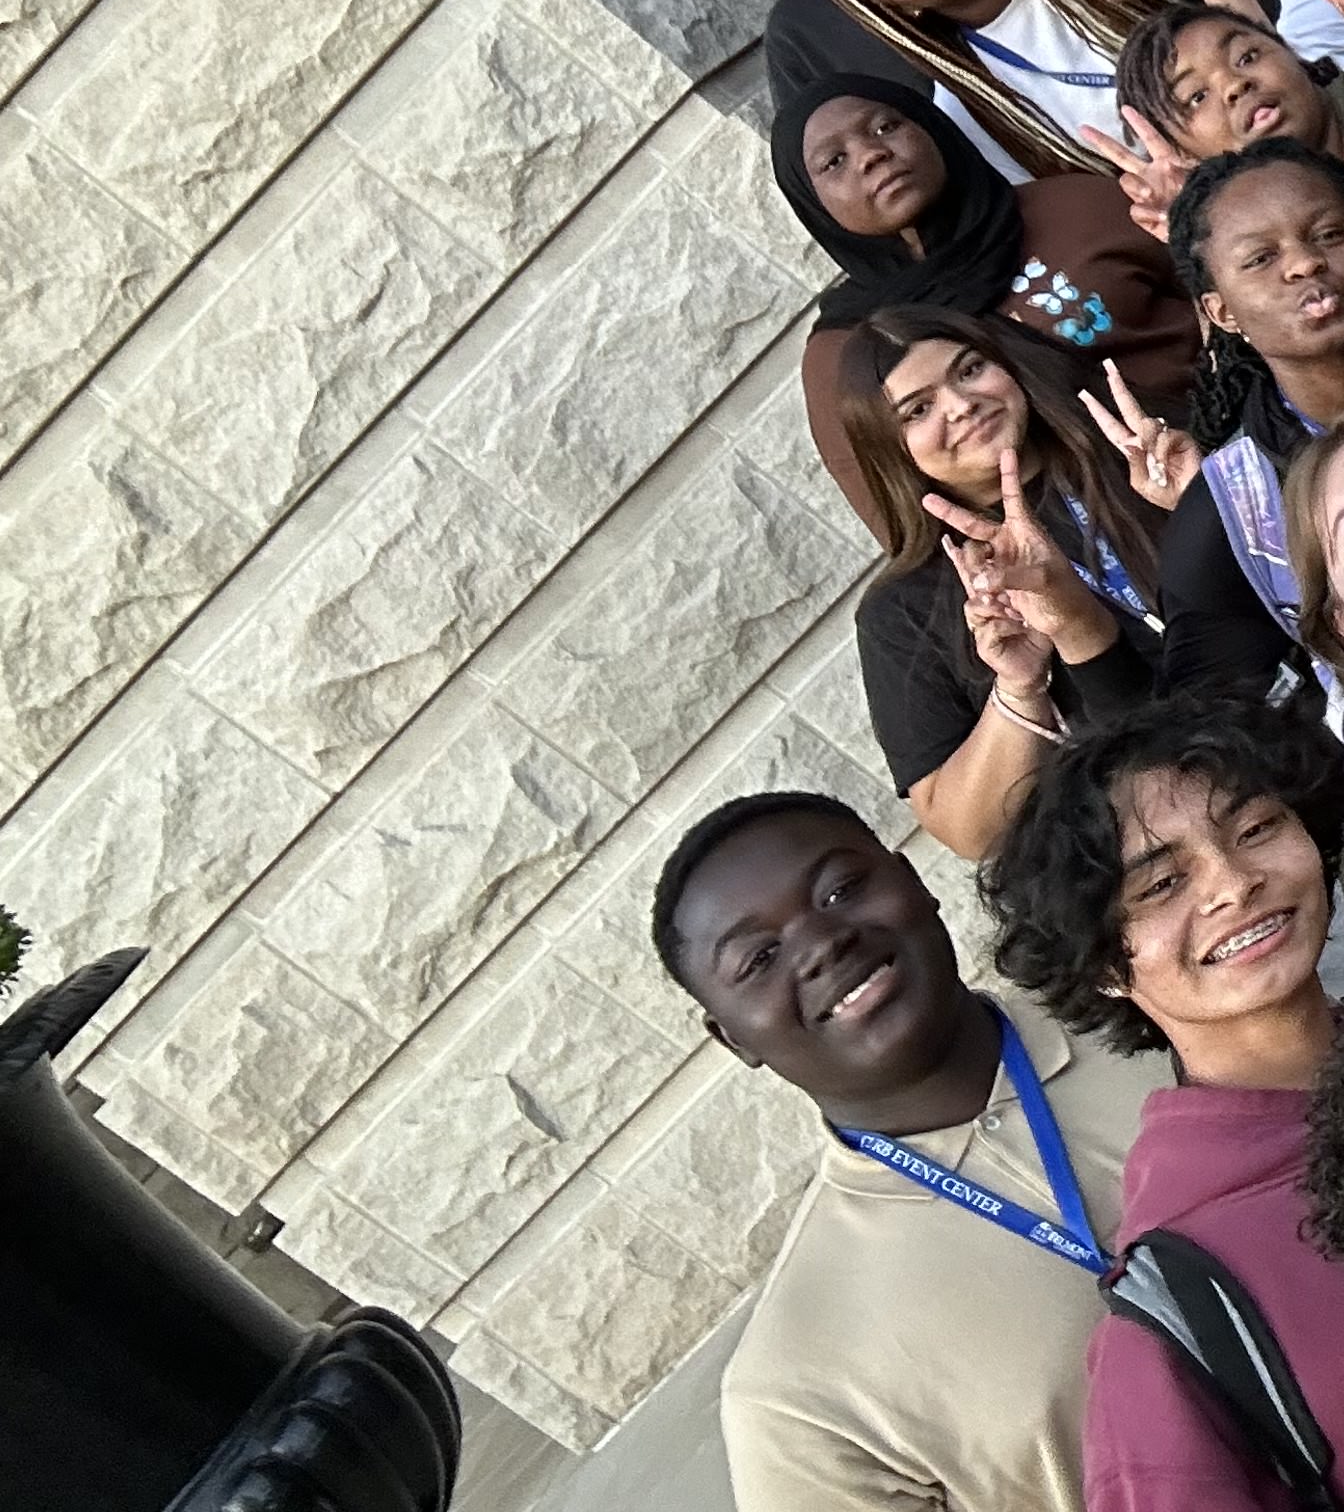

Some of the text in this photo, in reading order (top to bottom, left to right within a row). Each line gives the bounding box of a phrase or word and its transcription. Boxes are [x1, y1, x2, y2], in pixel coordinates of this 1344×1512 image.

[1068, 76, 1110, 85] CENTER
[892, 1149, 944, 1184] EVENT
[942, 1177, 1003, 1215] CENTER
